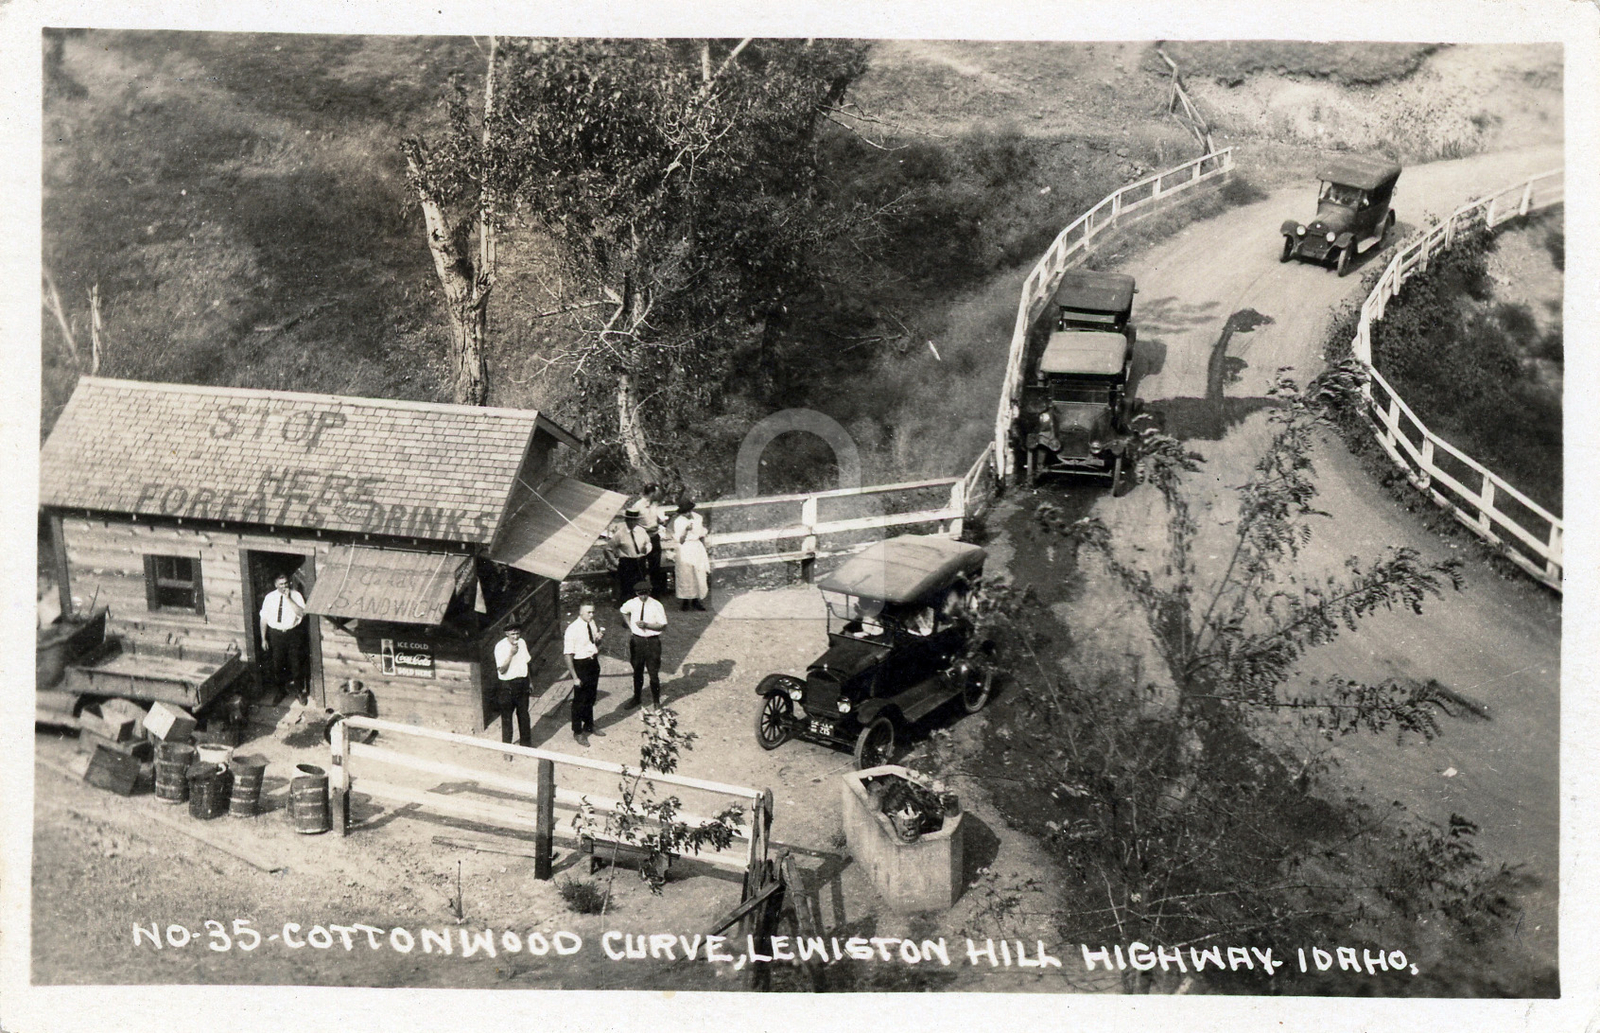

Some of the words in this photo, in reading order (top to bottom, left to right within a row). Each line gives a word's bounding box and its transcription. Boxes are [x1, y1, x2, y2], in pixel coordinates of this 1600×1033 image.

[210, 405, 347, 453] STOP
[256, 465, 386, 506] HERE
[133, 483, 217, 519] FOR
[356, 499, 497, 543] DRINKS
[410, 642, 429, 650] COLD
